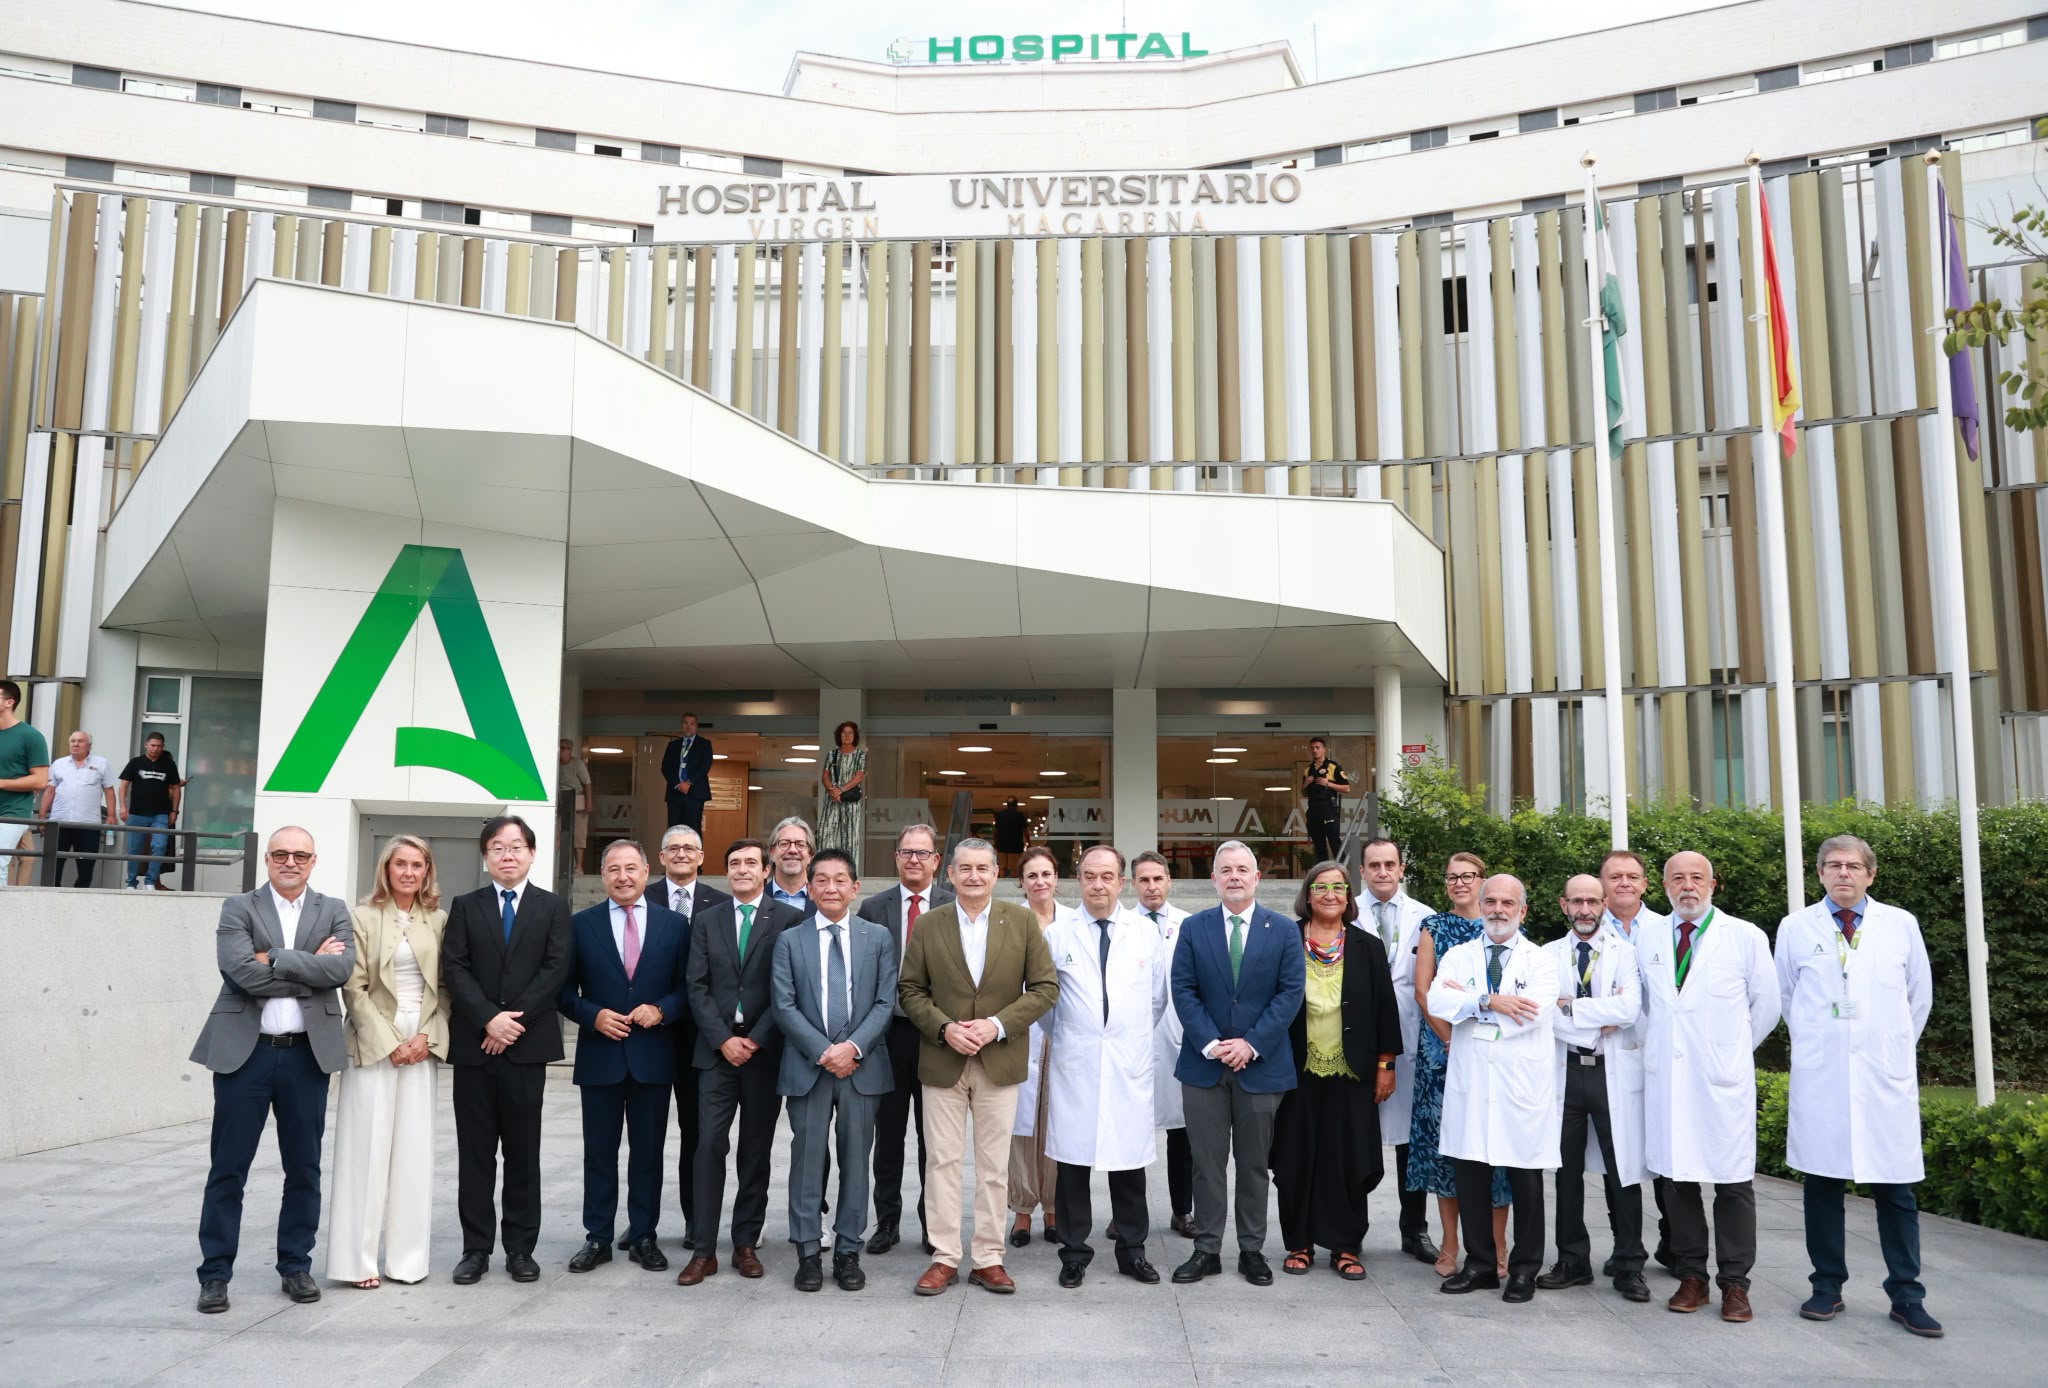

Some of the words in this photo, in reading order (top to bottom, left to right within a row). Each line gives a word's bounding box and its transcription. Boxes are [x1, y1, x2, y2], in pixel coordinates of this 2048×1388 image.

[928, 32, 1209, 63] HOSPITAL
[657, 181, 877, 215] HOSPITAL
[949, 171, 1302, 209] UNIVERSITARIO
[748, 215, 881, 240] VIRGEN
[1007, 209, 1208, 235] MACARENA
